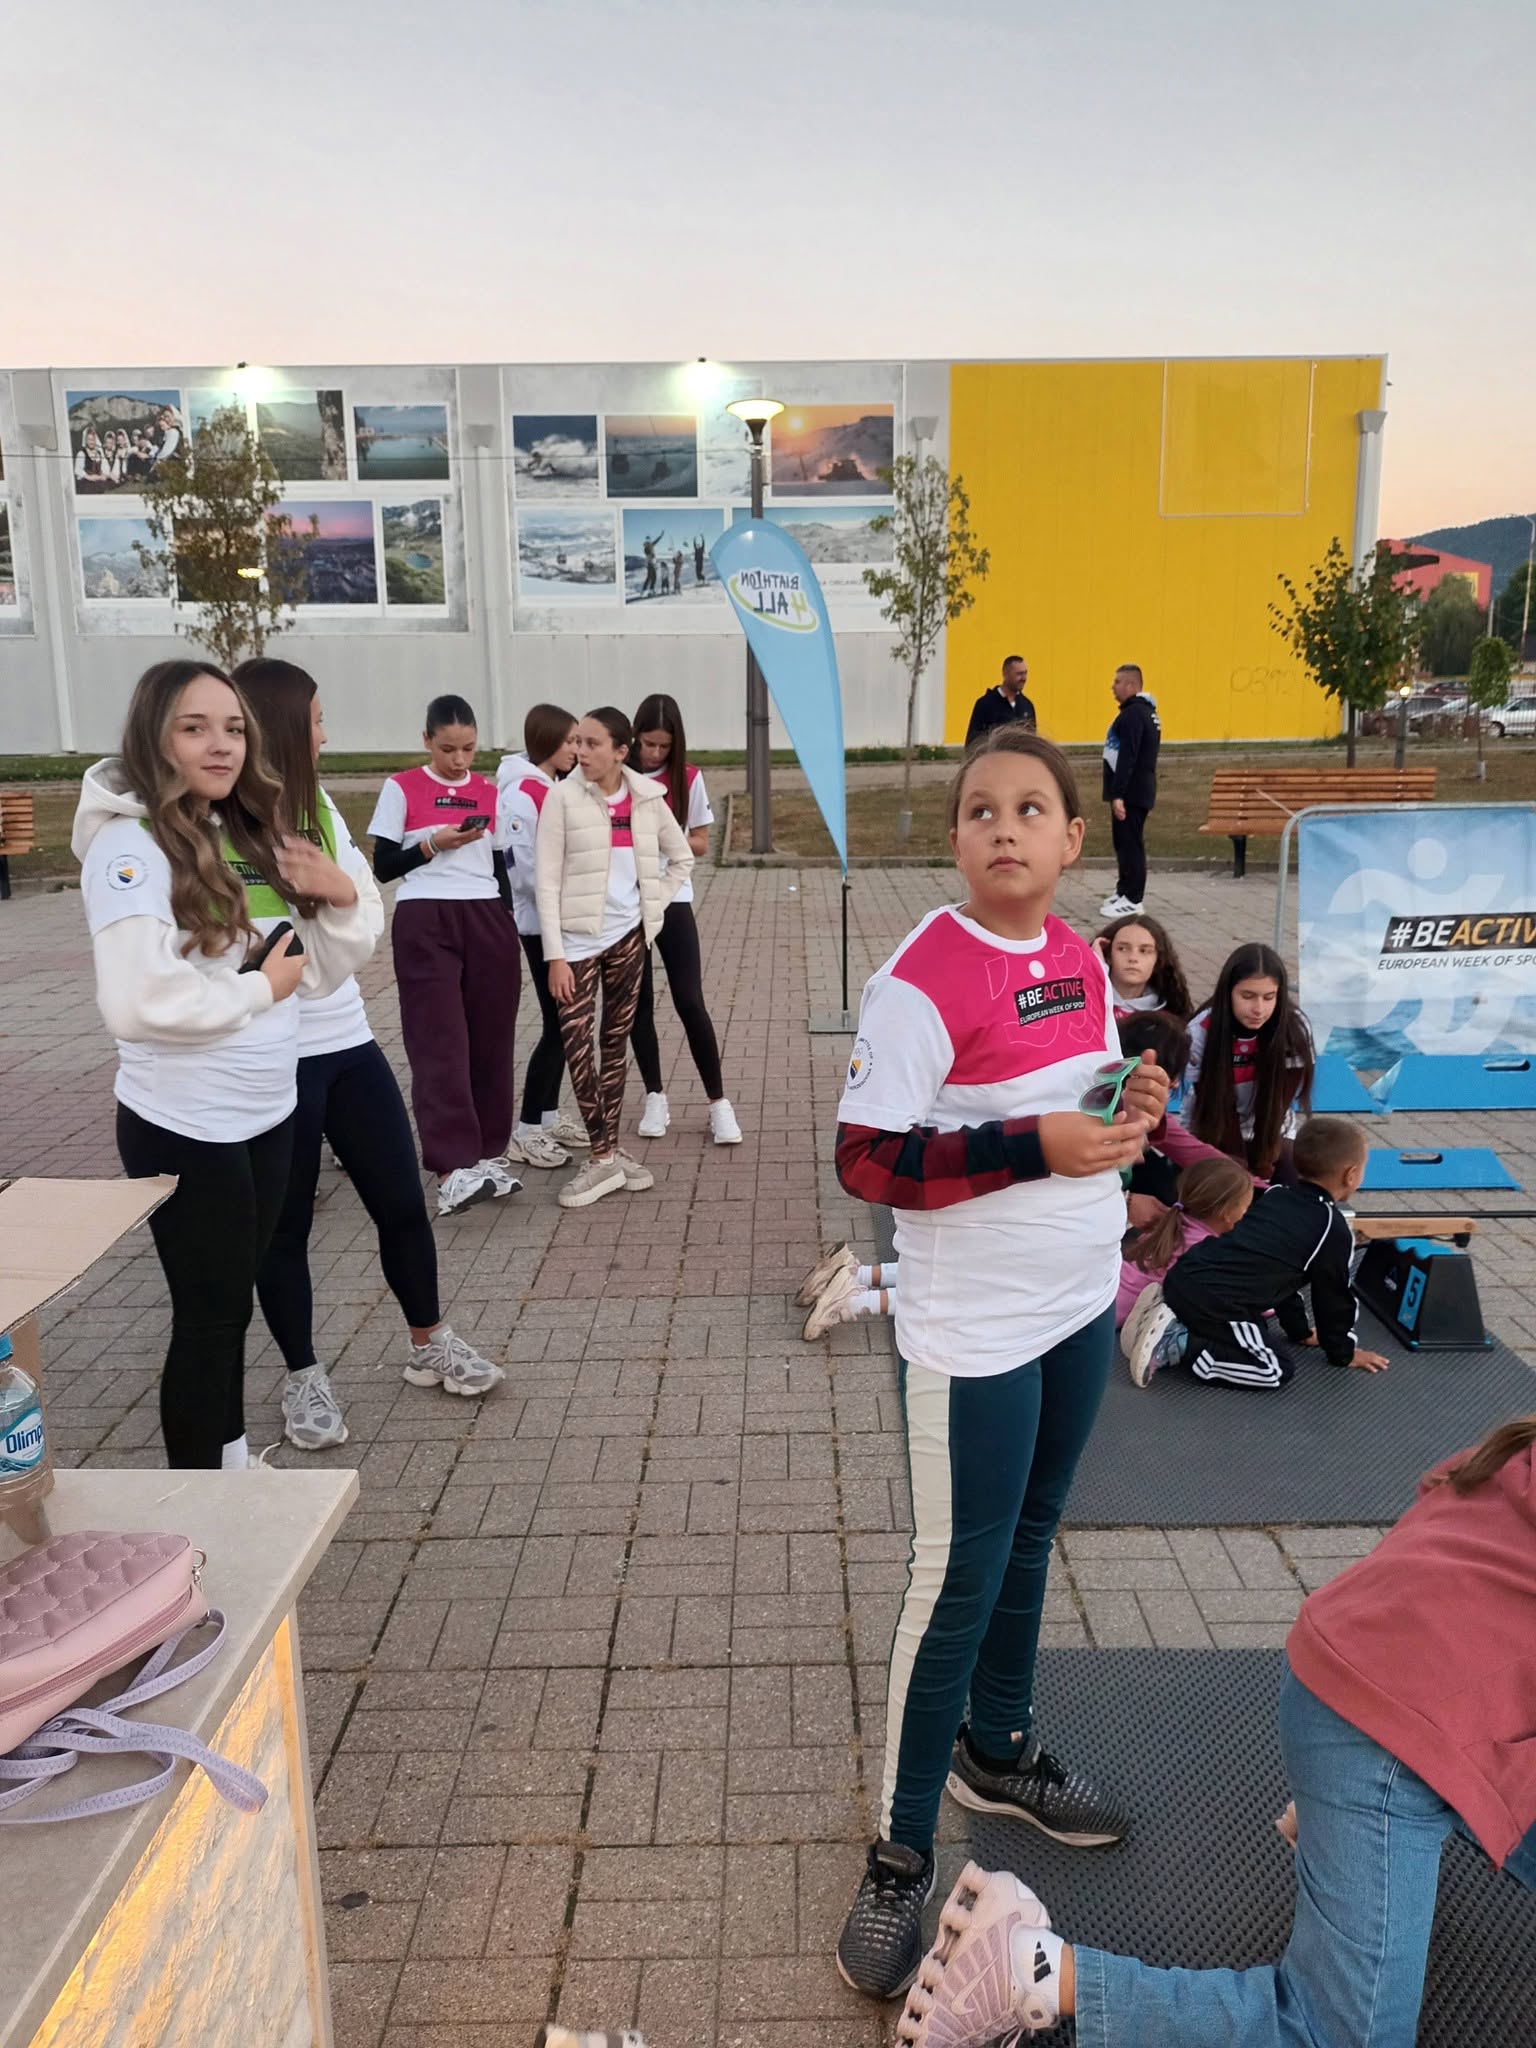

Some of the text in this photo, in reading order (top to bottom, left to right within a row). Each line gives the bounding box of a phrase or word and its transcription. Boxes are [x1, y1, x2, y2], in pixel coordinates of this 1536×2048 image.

[1377, 957, 1449, 970] EUROPEAN
[1452, 956, 1492, 967] WEEK
[1494, 955, 1515, 966] OF
[1018, 981, 1082, 1010] #BEACTIVE
[1020, 1009, 1049, 1024] EUROPEAN
[1048, 1005, 1065, 1016] WEEK
[1065, 1003, 1073, 1011] OF
[1407, 1277, 1420, 1308] 5
